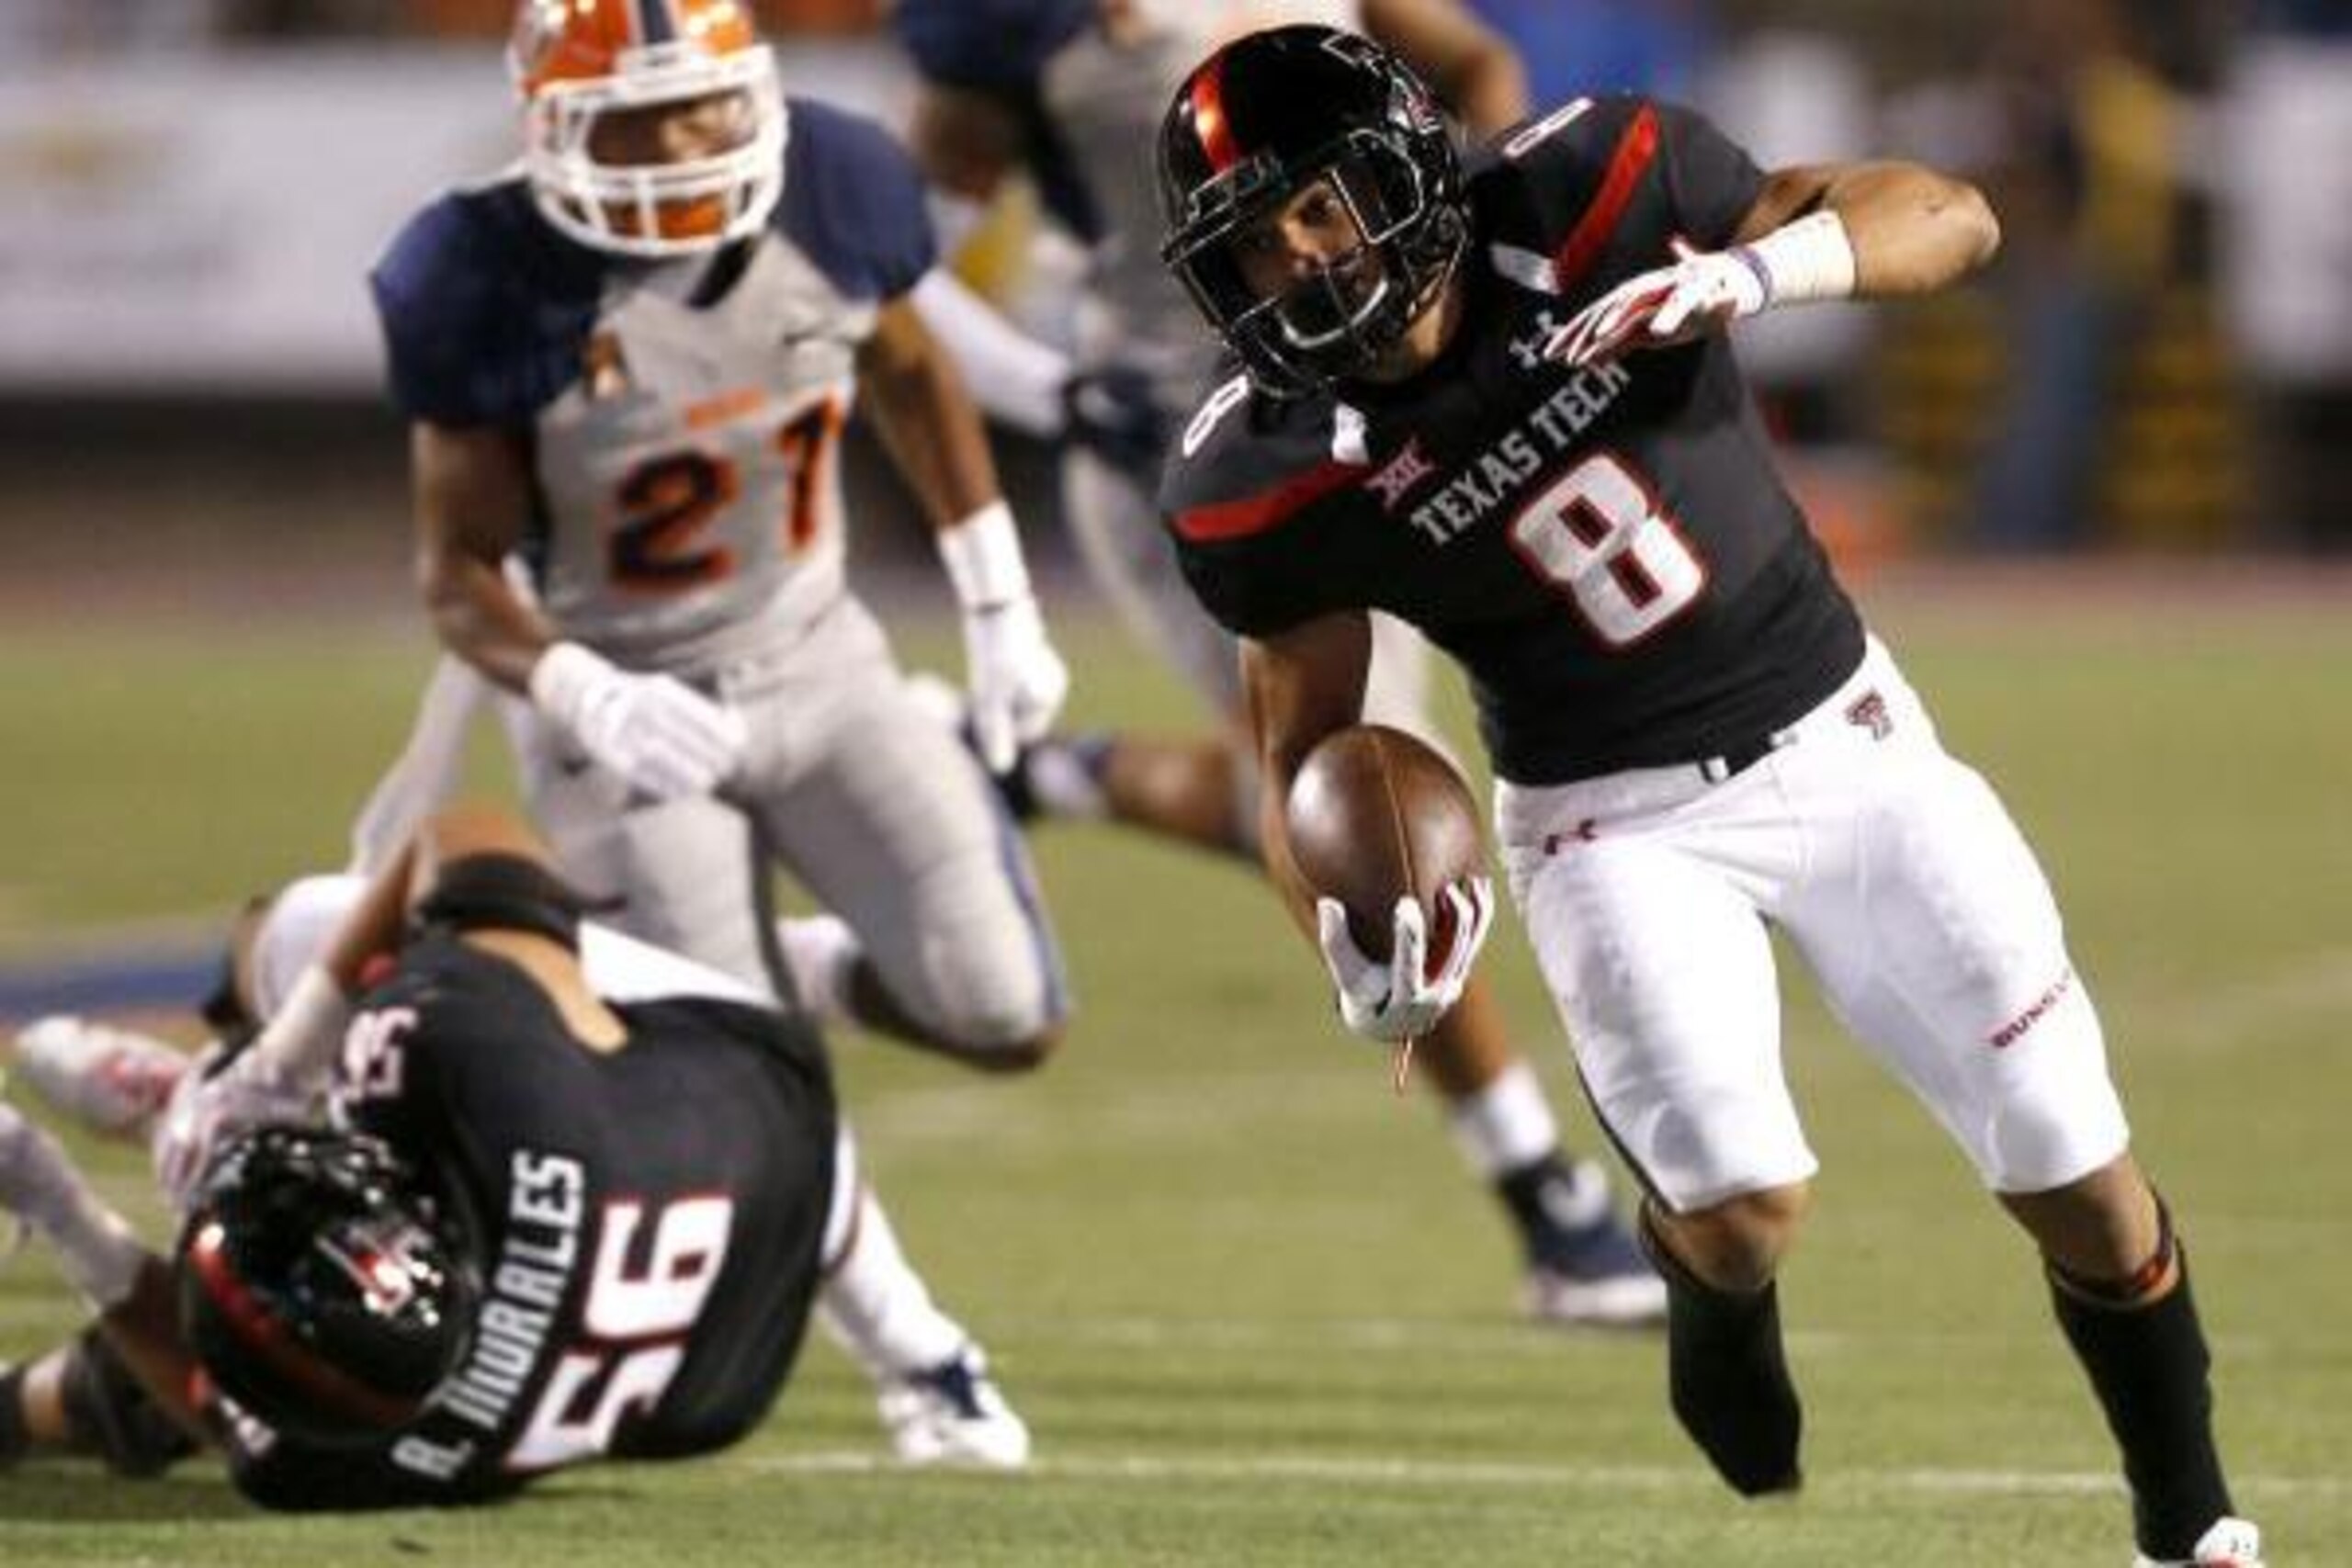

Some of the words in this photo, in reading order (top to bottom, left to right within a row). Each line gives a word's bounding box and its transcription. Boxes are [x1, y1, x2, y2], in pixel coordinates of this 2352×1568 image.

[608, 389, 845, 595] 21
[1409, 429, 1543, 546] TEXAS
[1528, 360, 1632, 450] TECH
[1505, 448, 1706, 649] 8
[502, 1193, 736, 1472] 56
